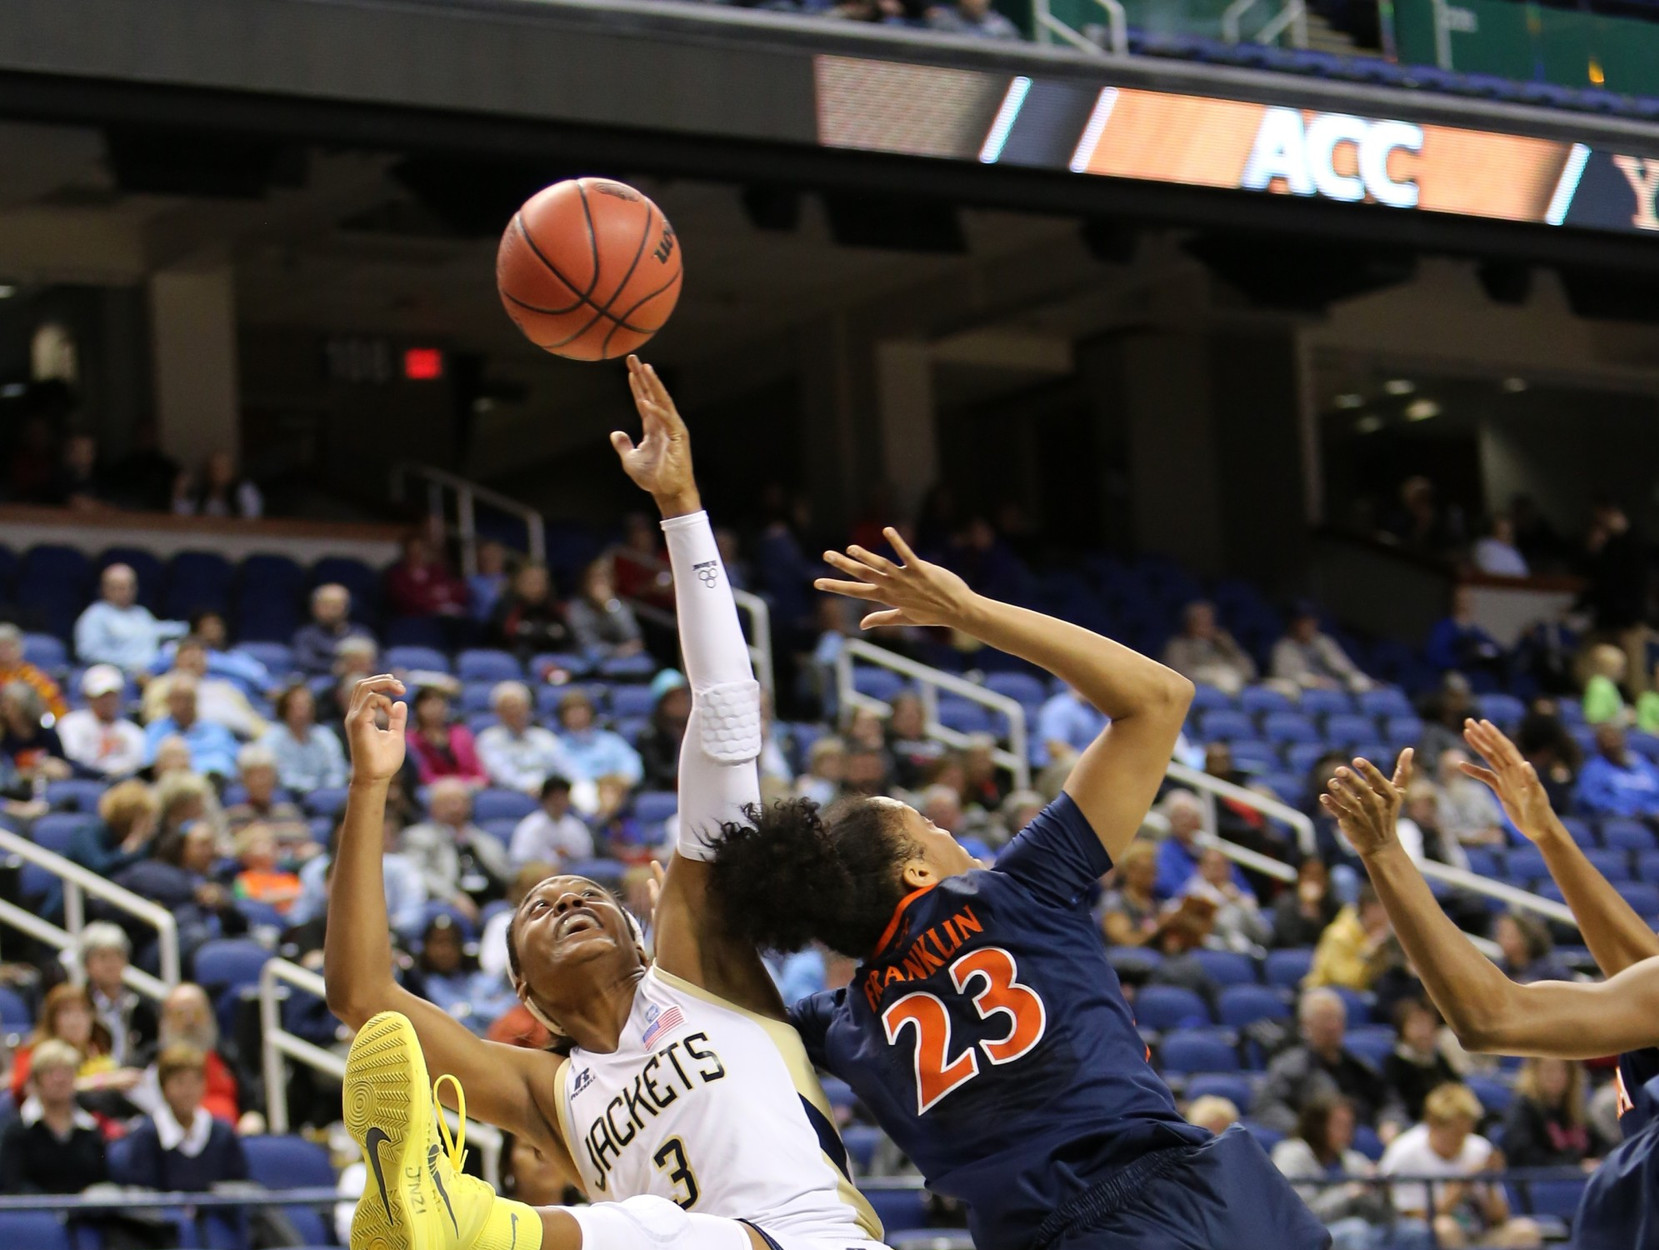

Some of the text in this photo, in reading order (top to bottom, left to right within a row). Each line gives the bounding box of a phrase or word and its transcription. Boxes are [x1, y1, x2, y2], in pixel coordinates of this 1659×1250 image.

[1242, 106, 1424, 208] ACC
[863, 904, 984, 1013] FRANKLIN
[881, 946, 1047, 1116] 23
[584, 1032, 726, 1192] JACKETS
[652, 1133, 702, 1212] 3
